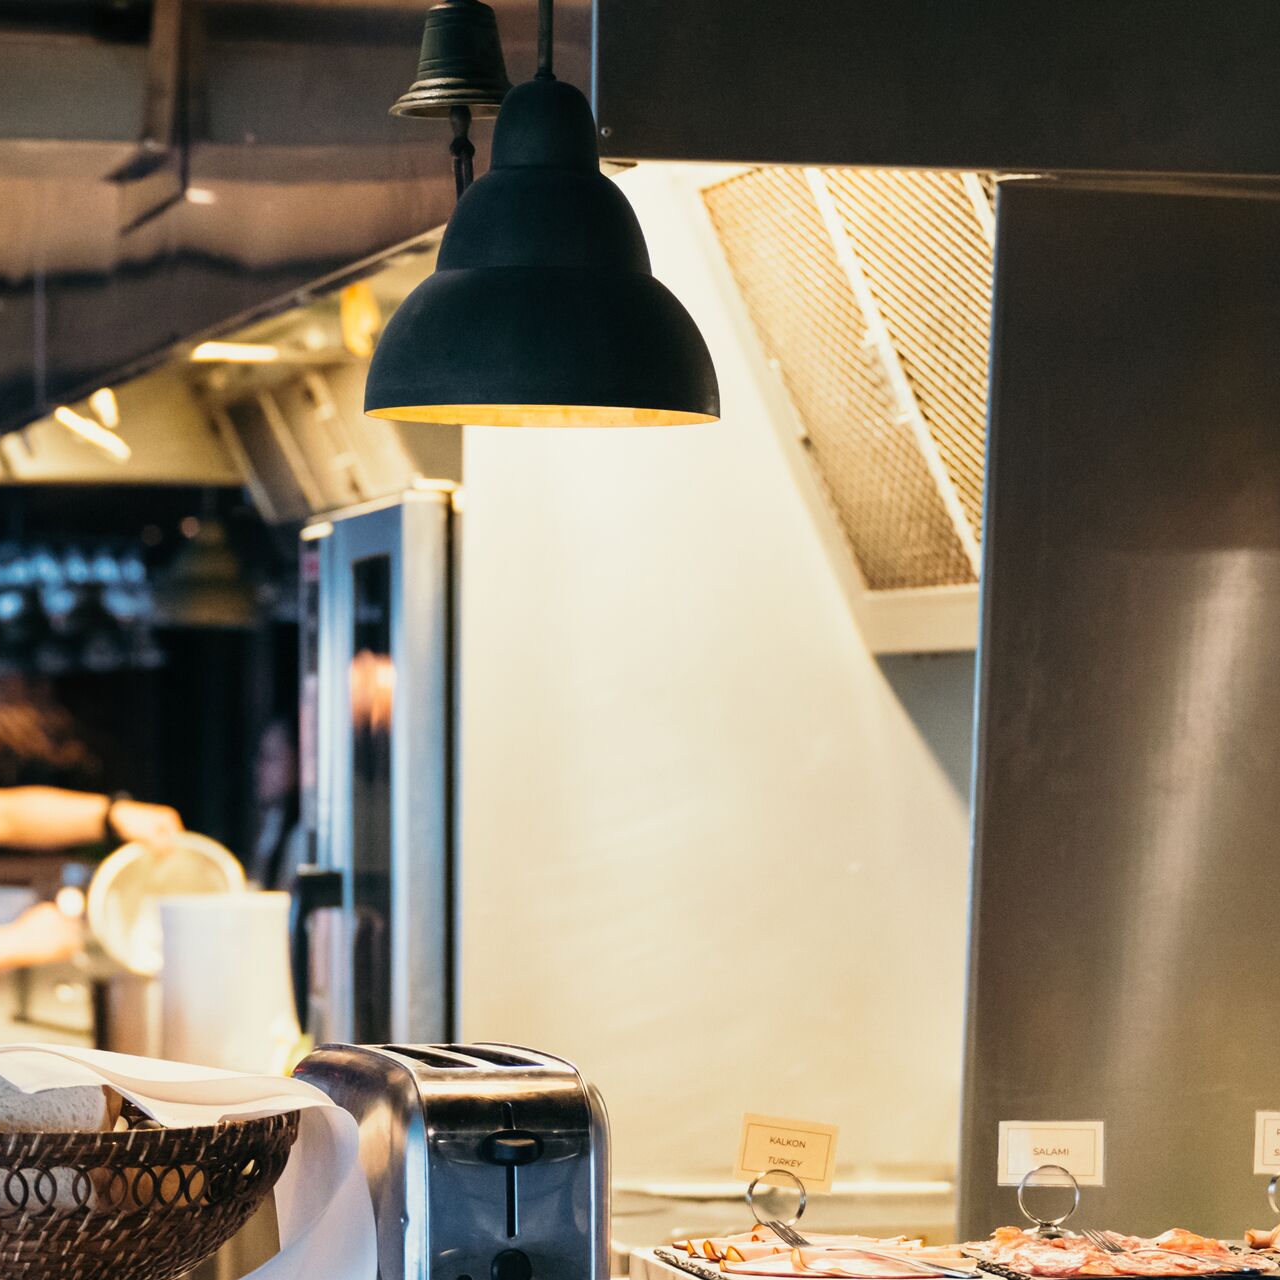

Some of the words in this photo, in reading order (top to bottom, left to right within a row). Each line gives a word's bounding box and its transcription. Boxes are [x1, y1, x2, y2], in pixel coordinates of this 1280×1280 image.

[769, 1136, 806, 1148] KALKON
[1033, 1147, 1069, 1156] SALAMI
[767, 1156, 802, 1167] TURKEY
